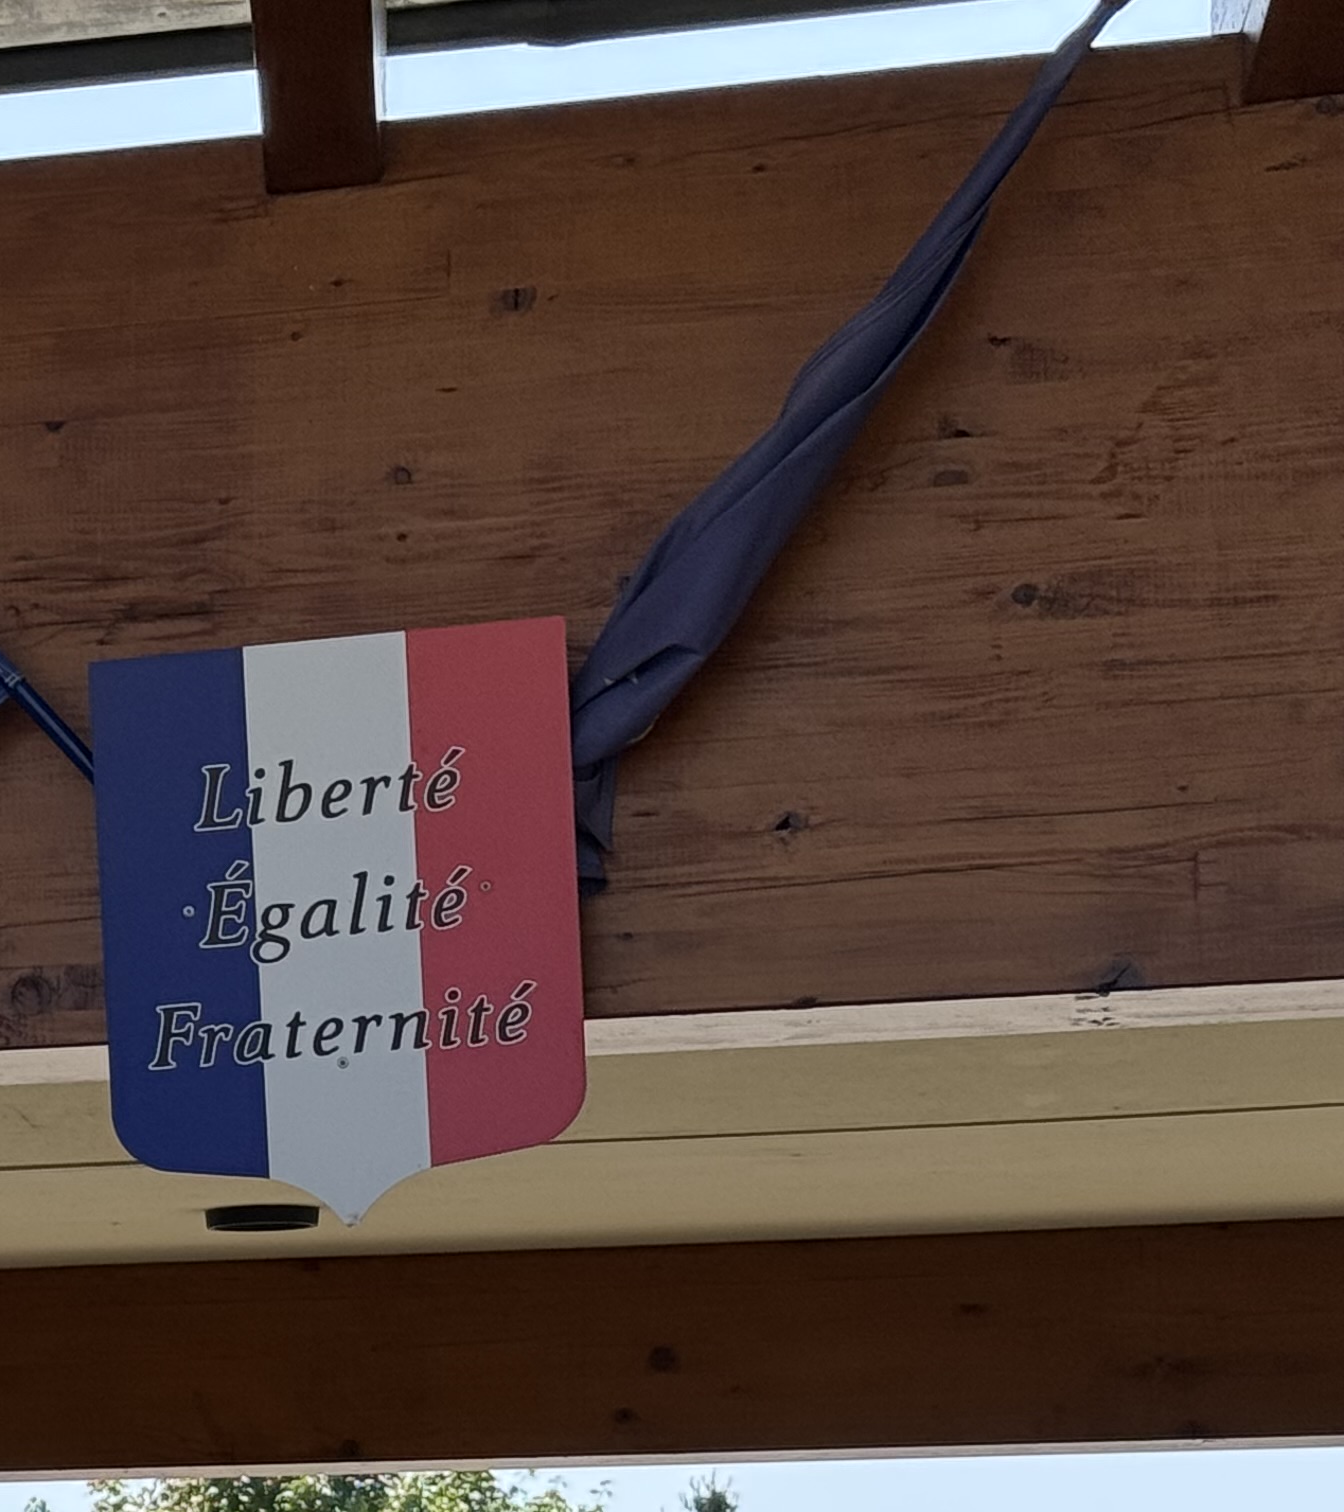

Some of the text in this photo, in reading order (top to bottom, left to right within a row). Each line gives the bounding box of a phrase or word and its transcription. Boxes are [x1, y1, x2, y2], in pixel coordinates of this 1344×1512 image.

[194, 746, 466, 832] Liberté
[199, 860, 472, 964] Égalité
[148, 980, 538, 1070] Fraternité
